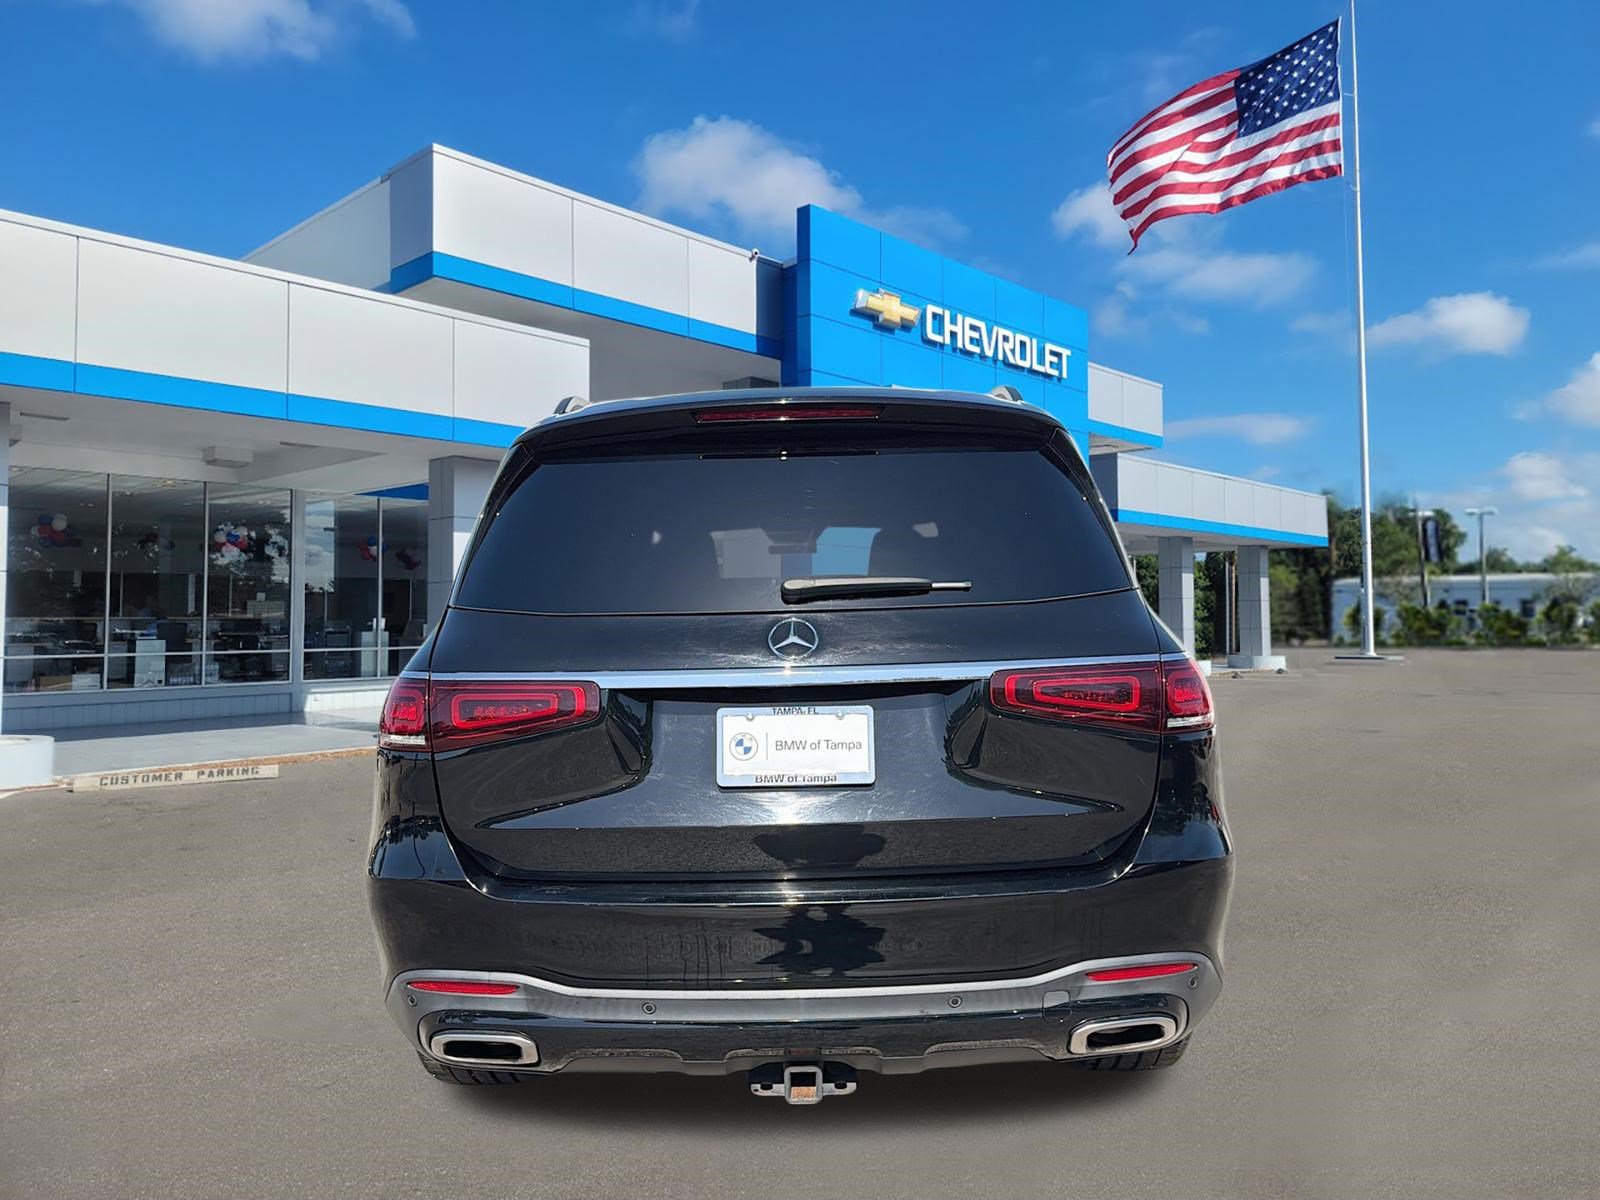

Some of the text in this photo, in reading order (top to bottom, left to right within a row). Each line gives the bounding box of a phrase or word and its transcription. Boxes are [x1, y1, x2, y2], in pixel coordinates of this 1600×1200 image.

[926, 304, 1072, 379] CHEVROLET
[775, 739, 862, 752] BMW of Tampa
[99, 766, 259, 786] CUSTOMER PARKING
[755, 774, 785, 783] BMW
[787, 774, 798, 783] of
